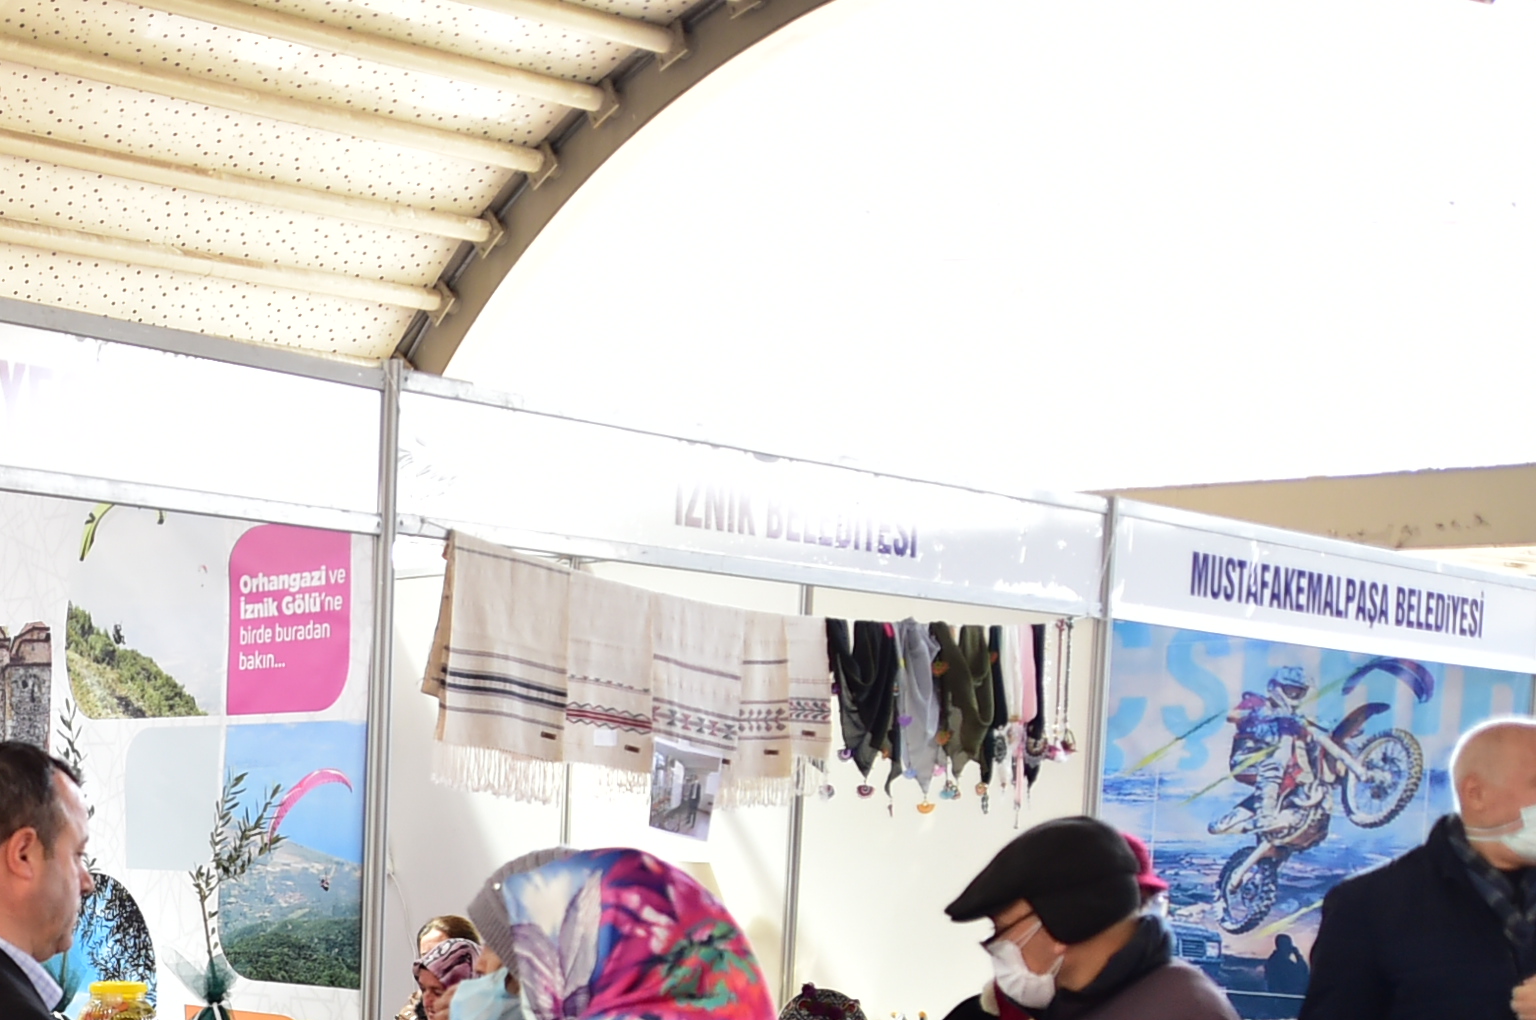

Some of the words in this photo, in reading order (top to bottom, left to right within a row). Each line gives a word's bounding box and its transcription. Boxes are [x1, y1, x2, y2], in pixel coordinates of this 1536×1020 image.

[239, 565, 326, 594] Orhangazi
[329, 568, 346, 584] ve
[1189, 550, 1390, 628] MUSTAFAKEMALPAŞA
[239, 624, 272, 645] birde
[275, 619, 331, 642] buradan
